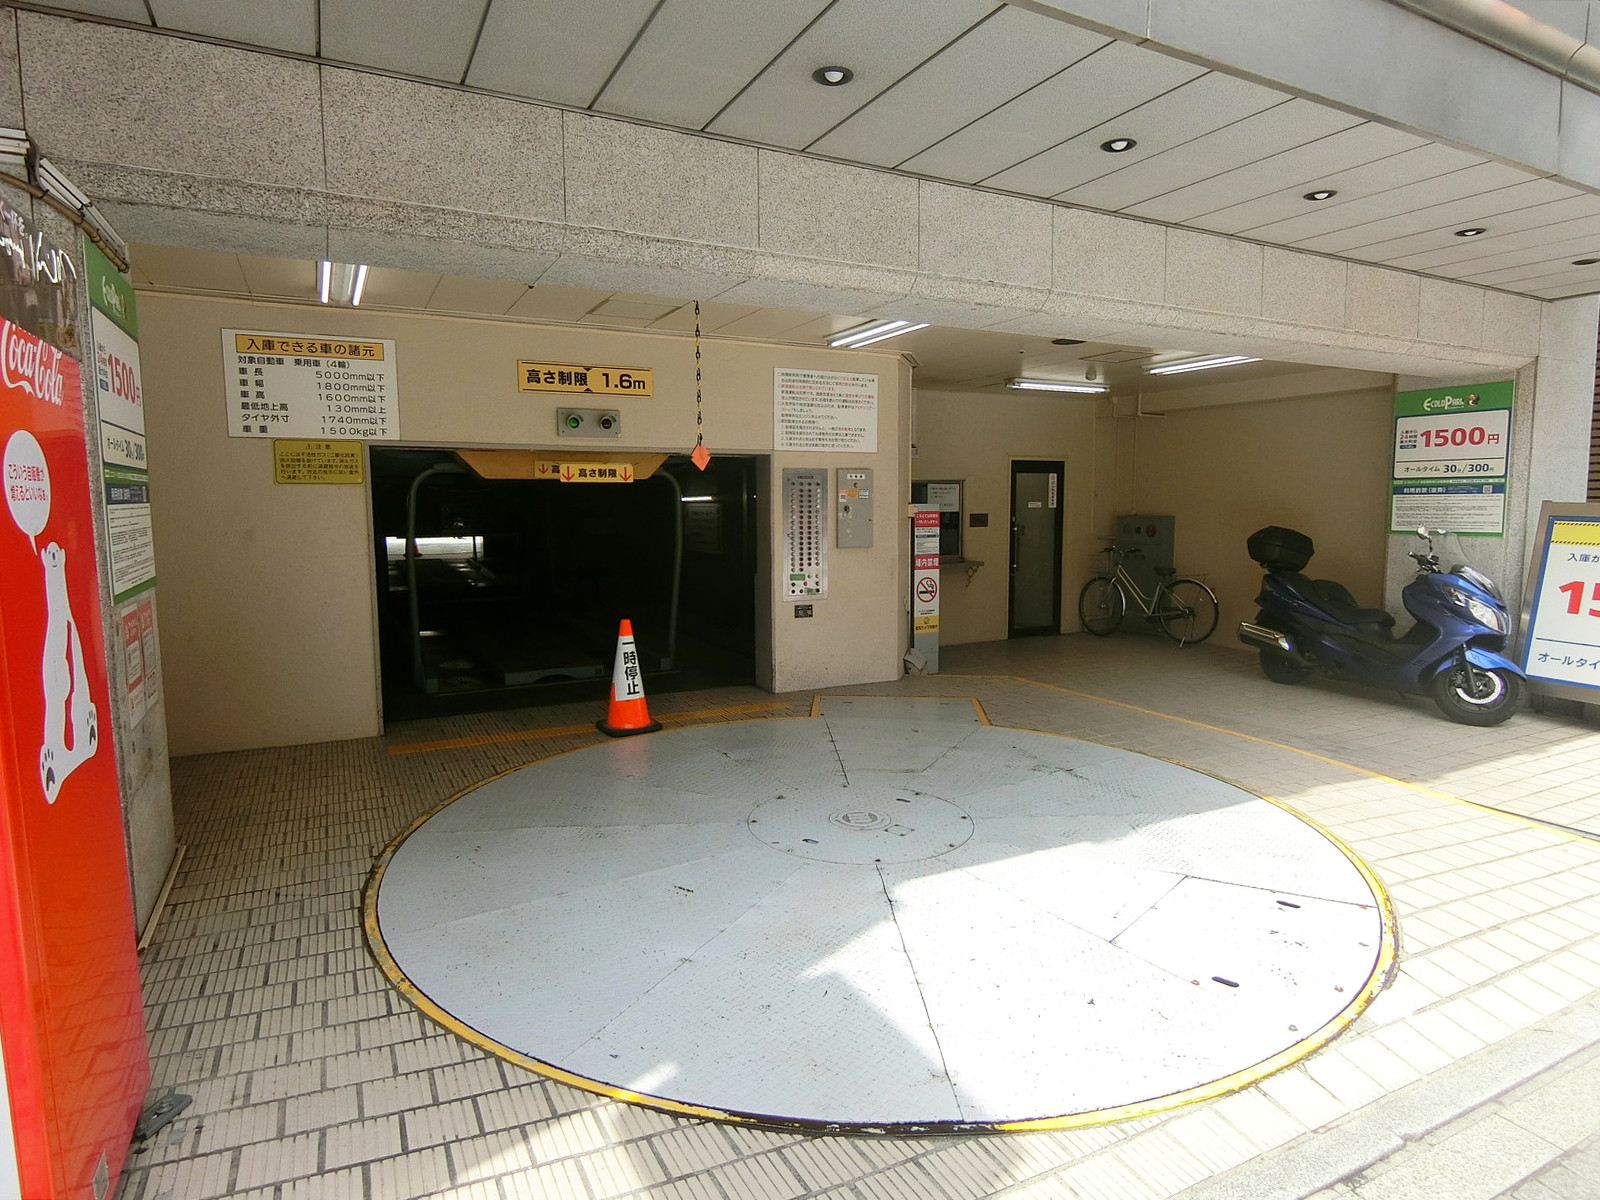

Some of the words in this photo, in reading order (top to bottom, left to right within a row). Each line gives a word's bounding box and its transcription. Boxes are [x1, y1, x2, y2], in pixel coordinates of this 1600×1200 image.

[246, 338, 376, 358] 入庫できる車の諸元
[1, 320, 64, 405] Coca-Cola
[237, 355, 285, 366] 対象自動車
[315, 371, 385, 381] 5000mm以下
[526, 369, 588, 386] 高さ制限
[602, 373, 646, 390] 1.6m
[317, 382, 385, 393] 1800mm以下
[318, 394, 386, 403] 1600mm以下
[241, 402, 289, 411] 最低地上高
[327, 405, 387, 414] 130mm以上
[241, 413, 290, 423] タイヤ外寸
[322, 416, 387, 425] 1740mm以下
[321, 427, 388, 437] 1500kg以下
[1420, 427, 1500, 448] 1500円
[578, 468, 617, 478] 高さ制限
[1403, 465, 1440, 473] オールタイム
[622, 641, 640, 696] 一時停止
